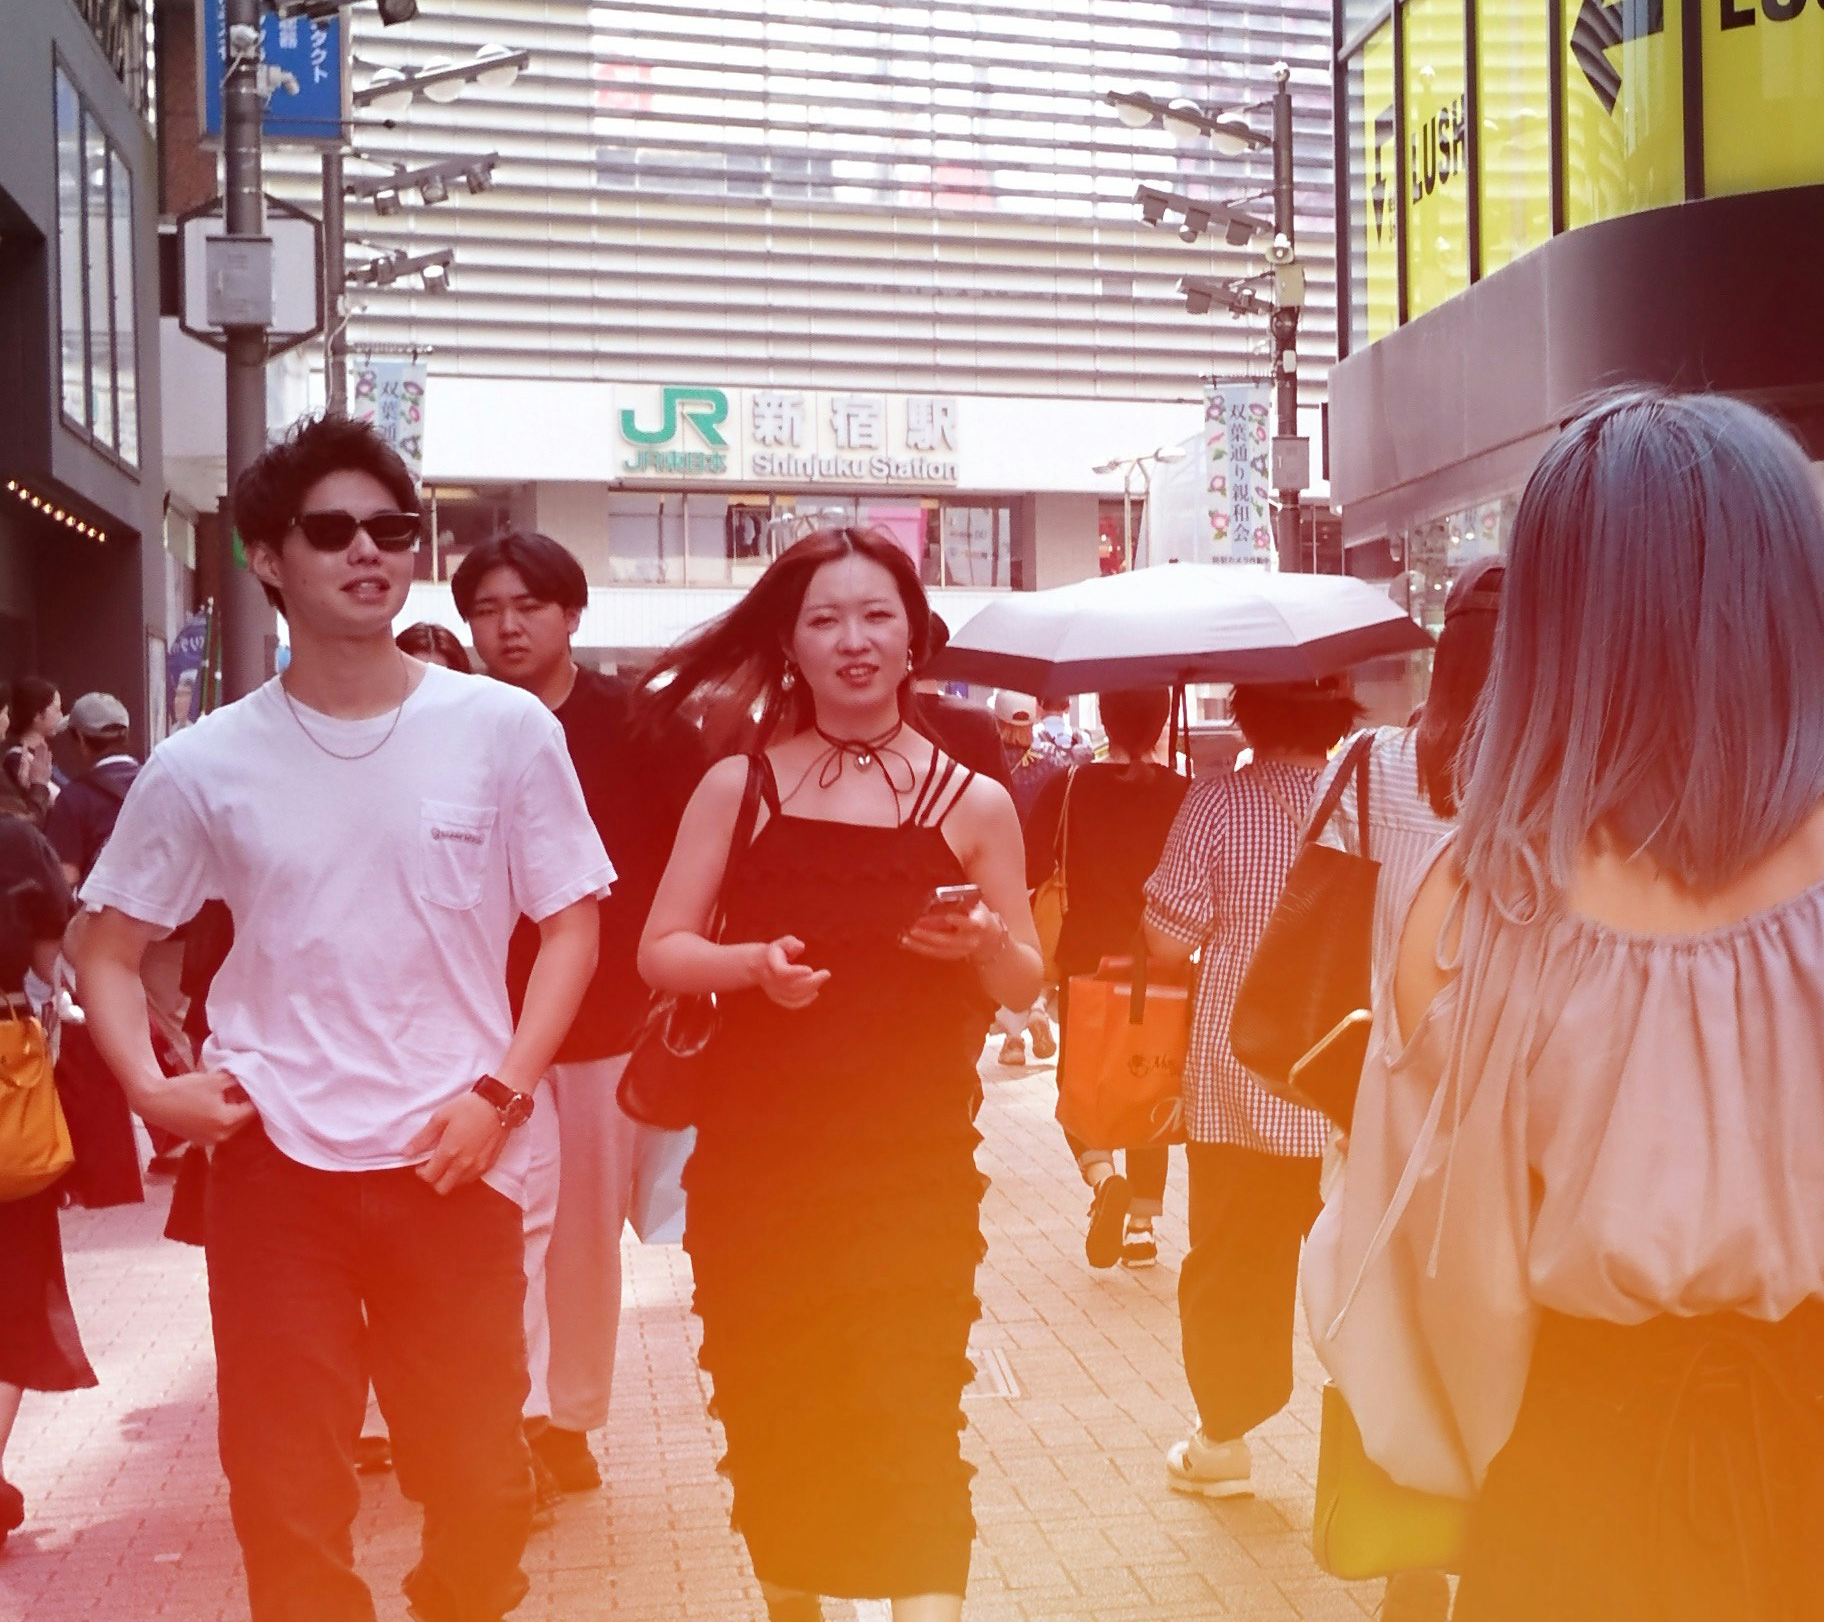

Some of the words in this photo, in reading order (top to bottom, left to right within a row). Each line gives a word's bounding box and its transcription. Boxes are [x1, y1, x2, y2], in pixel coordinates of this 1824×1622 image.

[1412, 94, 1465, 205] LUSH
[620, 385, 730, 449] JR
[752, 391, 957, 452] 新宿駅
[752, 454, 864, 481] Shinjuku
[869, 456, 959, 481] Station
